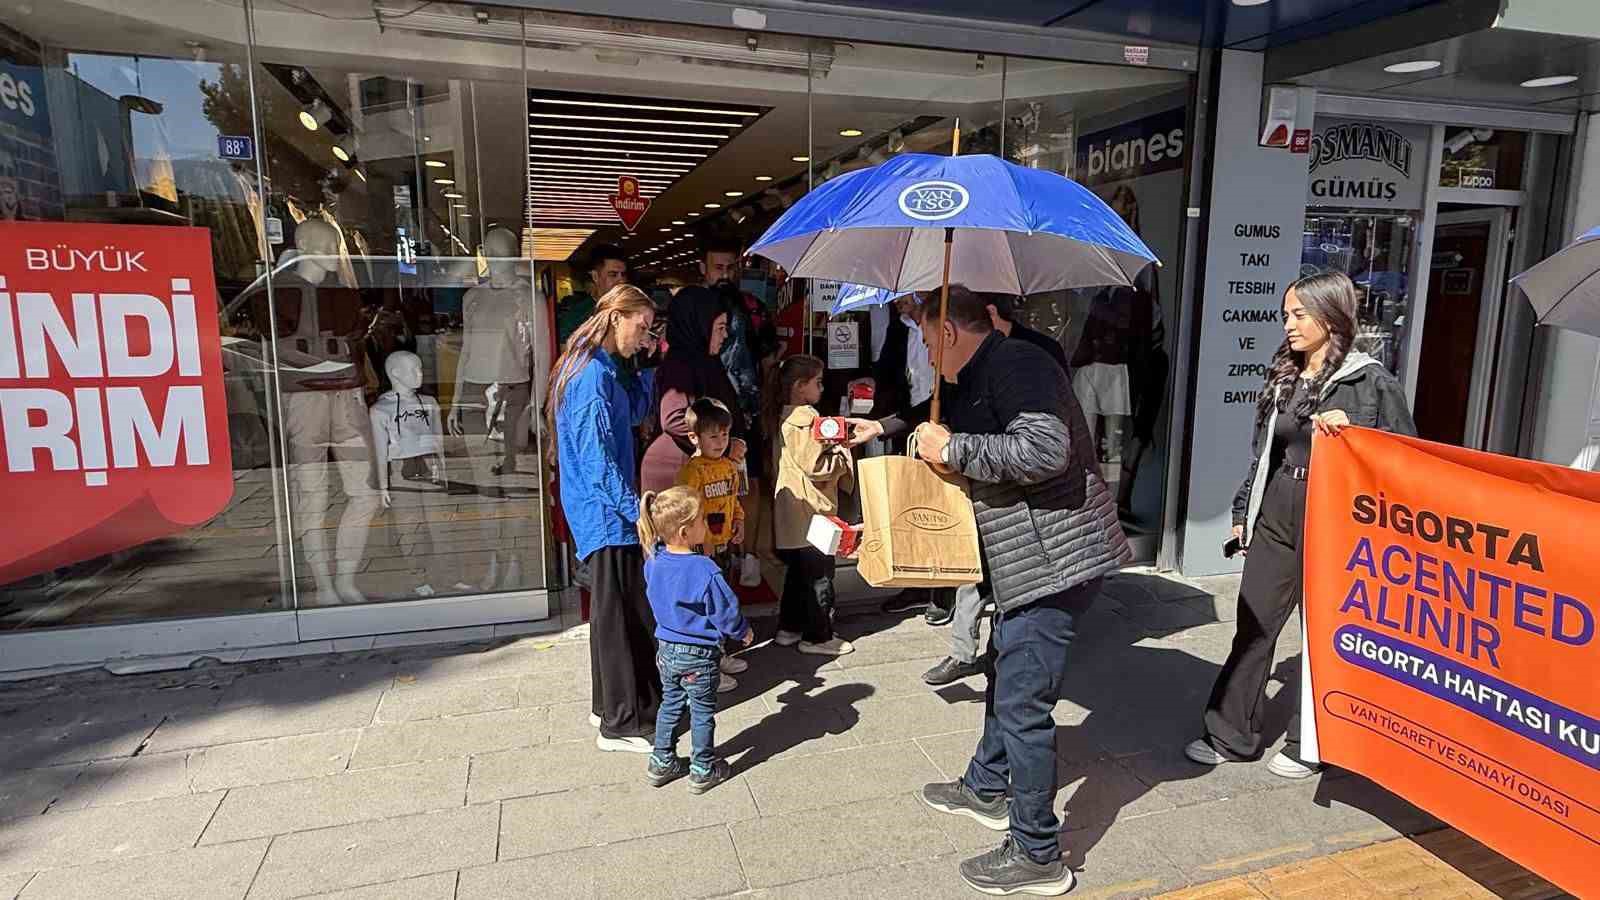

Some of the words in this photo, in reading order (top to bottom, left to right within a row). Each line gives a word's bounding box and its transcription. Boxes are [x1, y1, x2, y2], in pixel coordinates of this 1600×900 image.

[1088, 128, 1184, 177] bianes
[915, 191, 952, 199] VAN
[1311, 175, 1397, 201] GÜMÜŞ
[615, 197, 645, 210] indirim
[913, 199, 954, 209] TSO
[1234, 224, 1280, 238] GUMUS
[26, 244, 147, 272] BÜYÜK
[1240, 253, 1270, 267] TAKI
[1228, 281, 1275, 295] TESBIH
[1223, 309, 1278, 322] CAKMAK
[1239, 337, 1255, 350] VE
[1228, 364, 1265, 377] ZIPPO
[1351, 492, 1545, 573] SİGORTA
[1345, 537, 1595, 646] ACENTED
[1339, 578, 1501, 670] ALINIR
[1339, 633, 1439, 685] SİGORTA
[1444, 670, 1551, 735] HAFTASI
[1559, 718, 1600, 755] KU
[1350, 703, 1378, 724] VAN
[1379, 714, 1436, 752] TİCARET
[1437, 744, 1456, 762] VE
[1457, 752, 1517, 791] SANAYİ
[1517, 783, 1570, 818] ODASI
